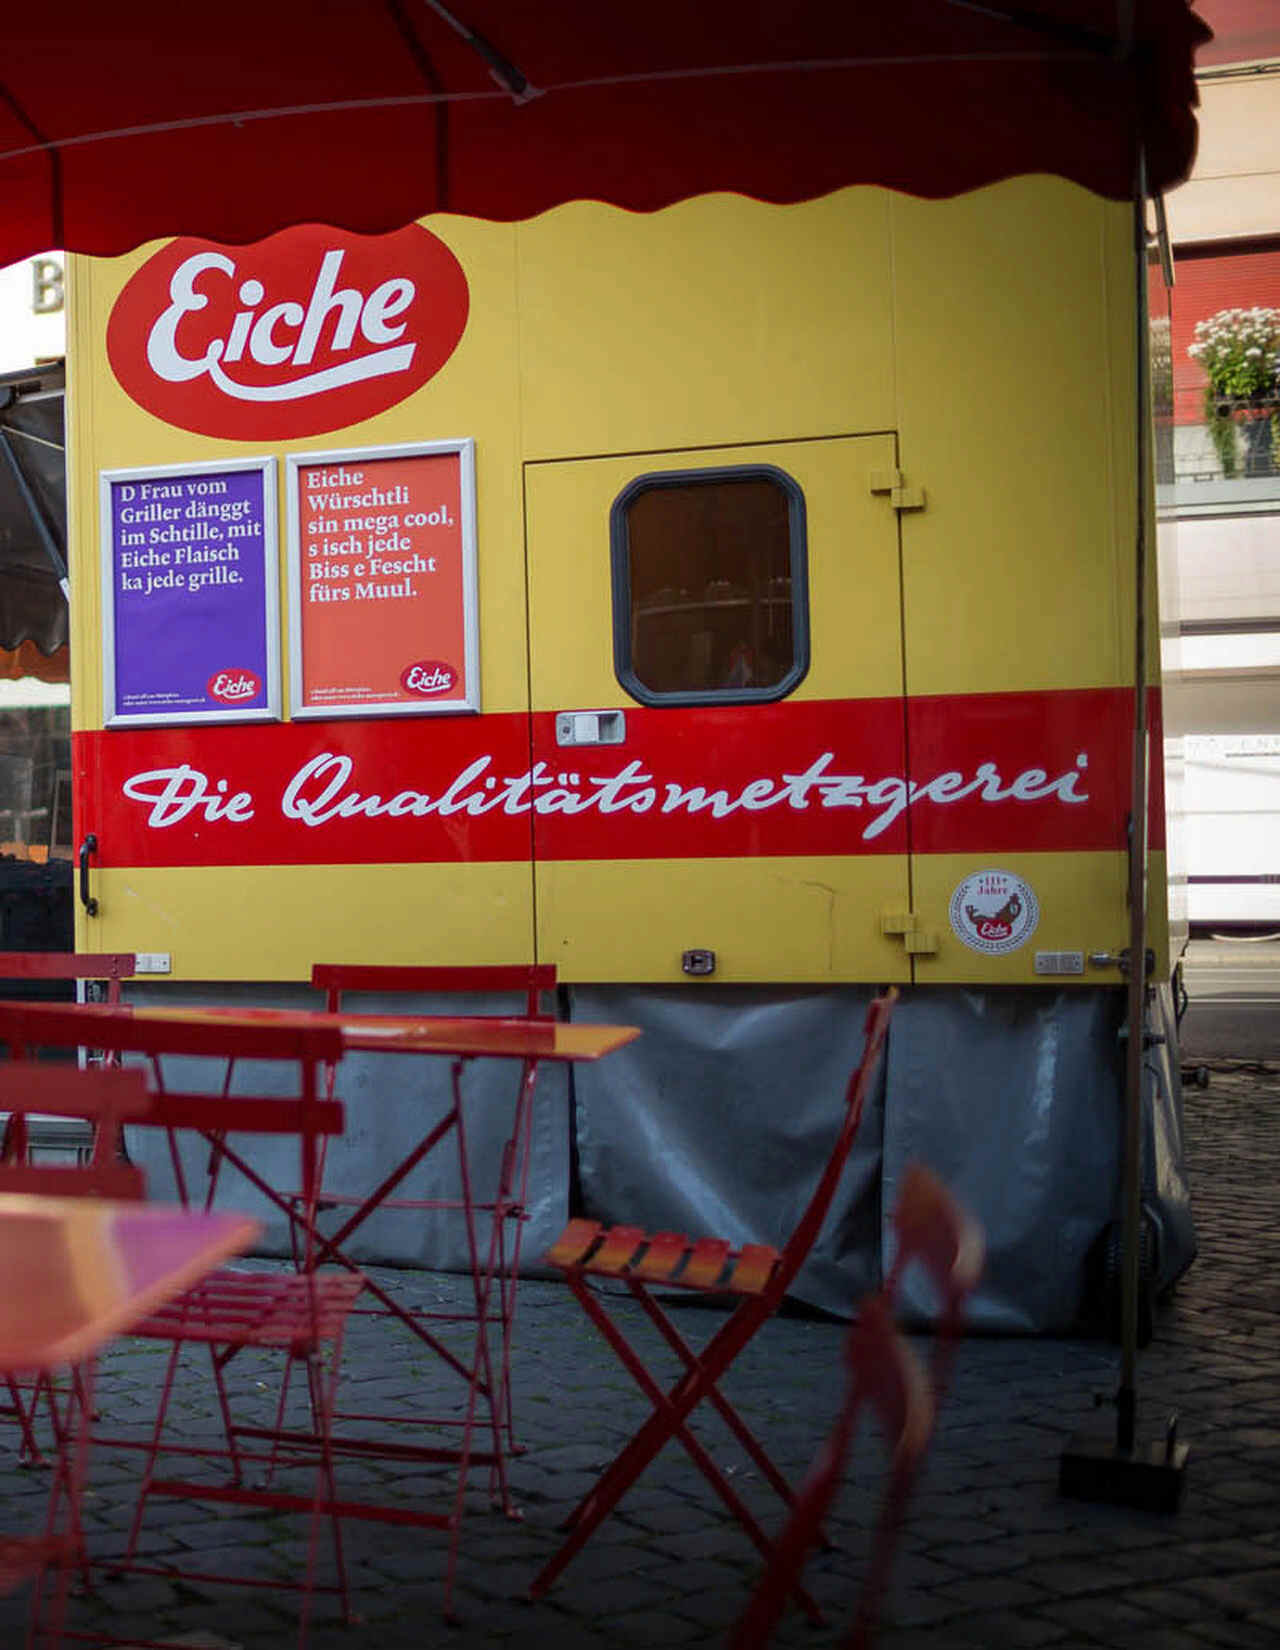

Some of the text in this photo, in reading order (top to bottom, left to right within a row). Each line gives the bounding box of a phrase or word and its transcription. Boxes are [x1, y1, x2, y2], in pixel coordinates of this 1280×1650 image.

[147, 248, 417, 403] Eiche
[121, 480, 228, 502] D Frau vom
[306, 467, 365, 489] Eiche
[121, 500, 251, 524] Griller dänggt
[306, 485, 410, 512] Würschtli
[308, 504, 454, 535] sin mega cool,
[121, 520, 262, 547] im Schtille, mit
[308, 532, 411, 560] s isch jede
[121, 543, 240, 568] Eiche Flaisch
[309, 553, 436, 580] Biss e Fescht
[121, 565, 244, 595] ka jede grille.
[309, 577, 417, 603] fürs Muul.
[213, 674, 256, 699] Eiche
[406, 666, 452, 692] Eiche
[122, 752, 1089, 840] Die Qualitätsmetzgerei
